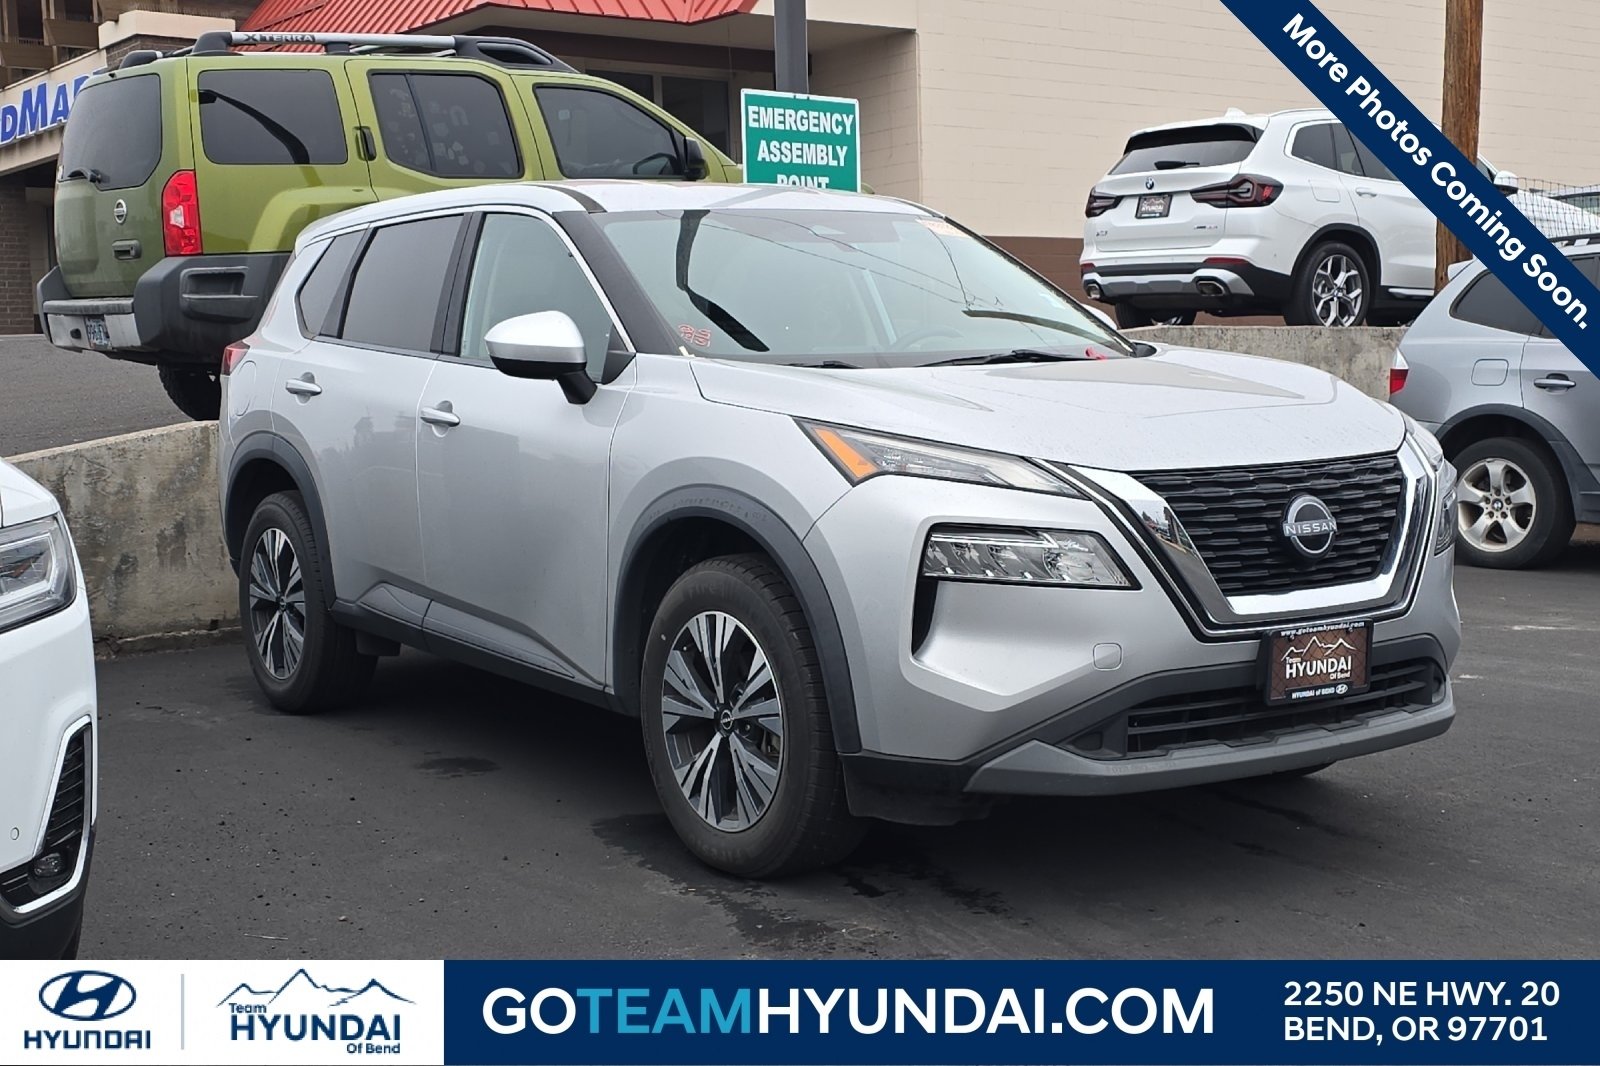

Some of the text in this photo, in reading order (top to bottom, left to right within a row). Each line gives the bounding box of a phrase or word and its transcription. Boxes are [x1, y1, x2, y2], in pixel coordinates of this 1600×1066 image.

[747, 105, 854, 135] EMERGENCY
[757, 139, 848, 166] ASSEMBLY
[1285, 521, 1337, 535] NISSAN
[1285, 656, 1352, 679] HYUNDAI
[1286, 656, 1301, 664] Team
[1337, 671, 1351, 679] Bend
